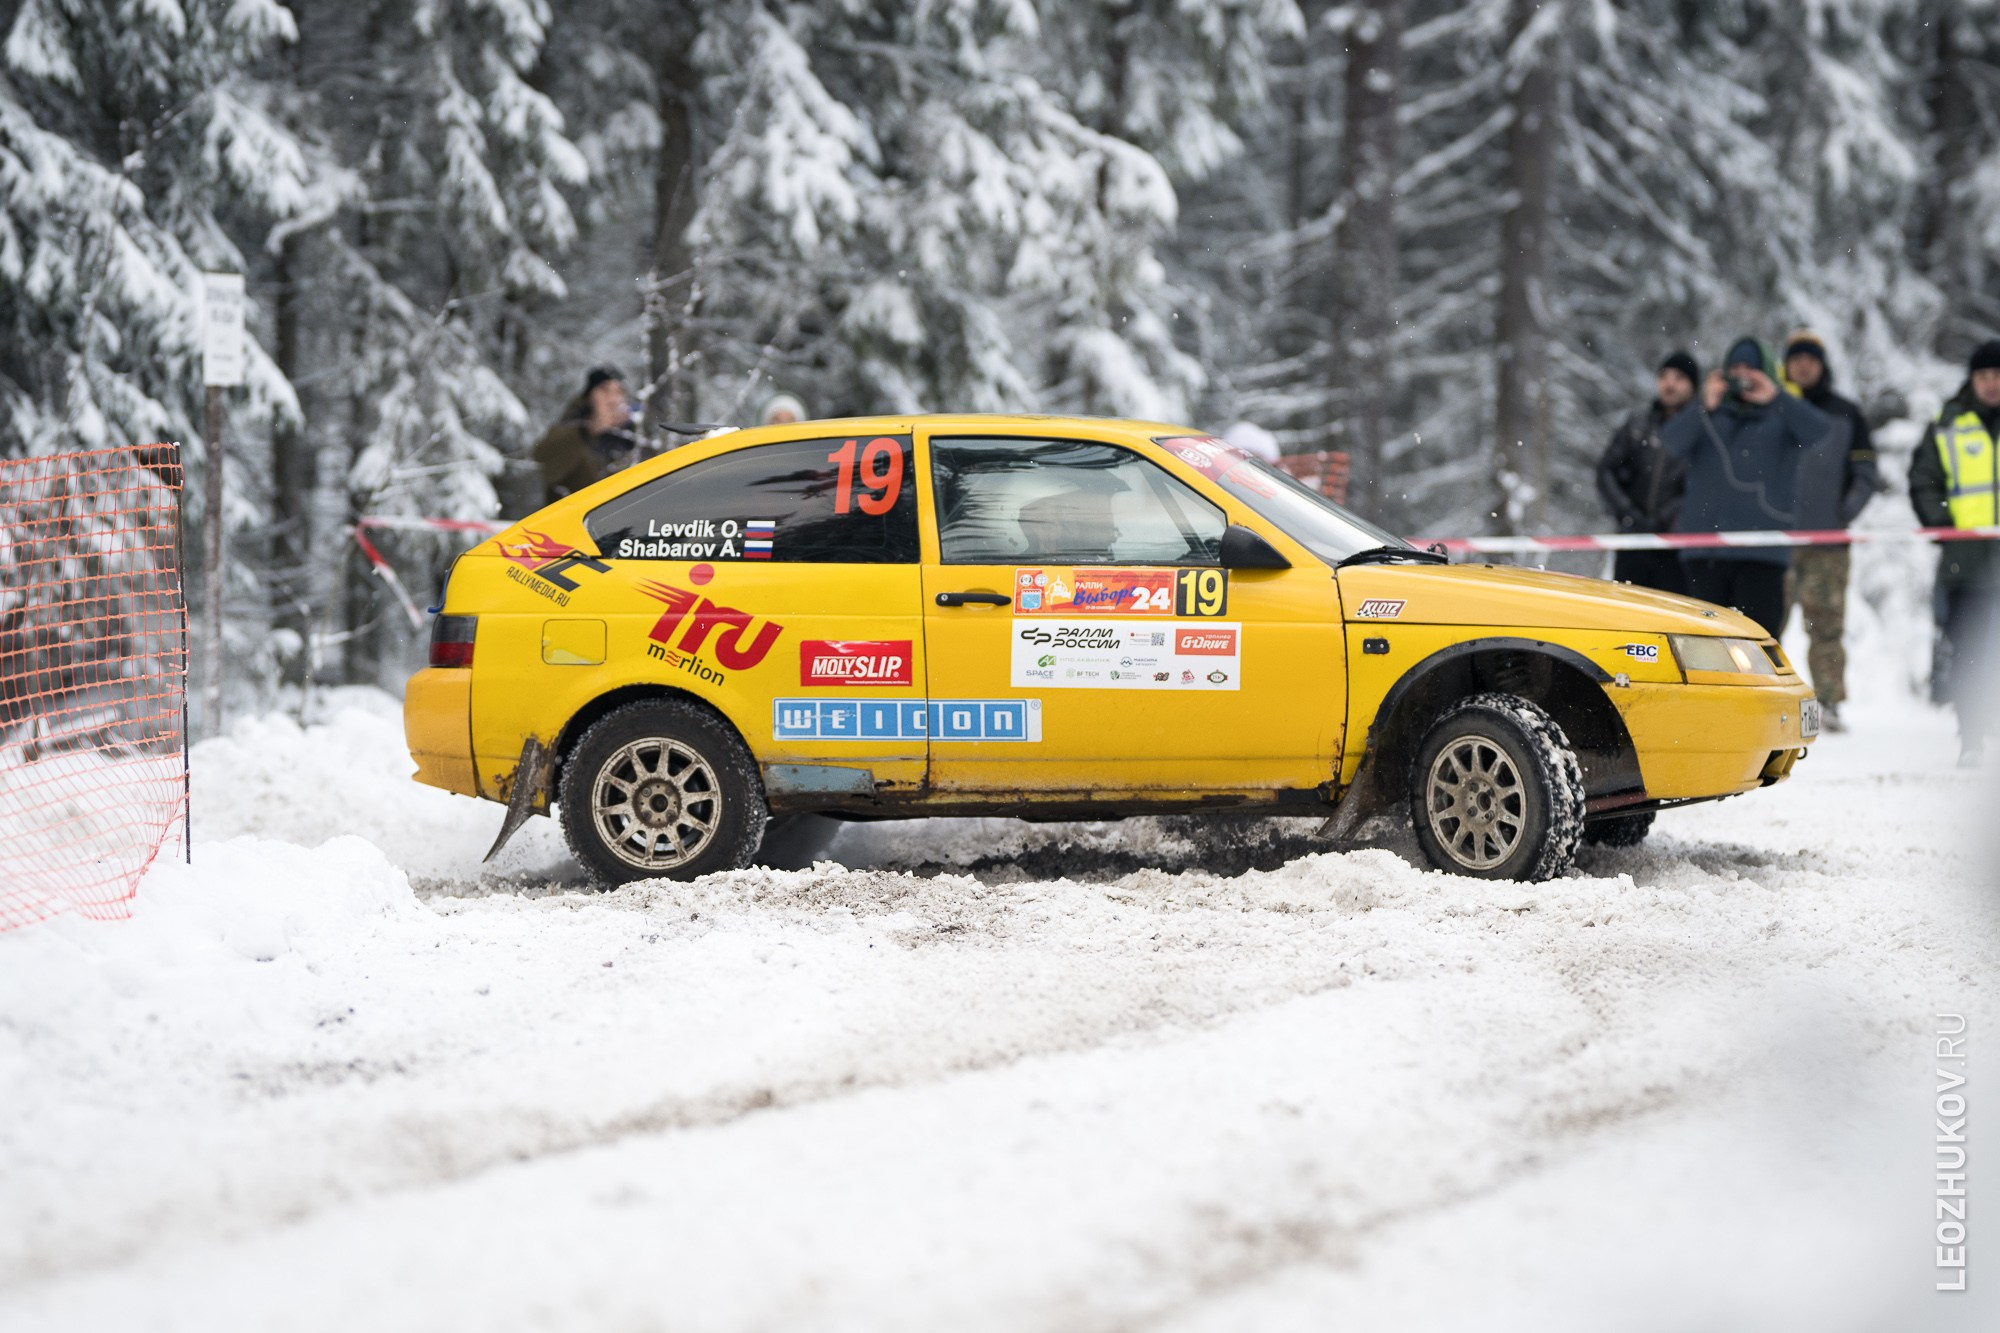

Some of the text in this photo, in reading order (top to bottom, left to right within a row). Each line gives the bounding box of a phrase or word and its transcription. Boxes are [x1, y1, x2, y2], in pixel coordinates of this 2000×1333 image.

[827, 437, 904, 516] 19
[648, 519, 743, 538] Levdik O.
[618, 538, 741, 557] Shabarov A.
[505, 565, 571, 608] RALLYMEDIA.RU
[1180, 569, 1224, 616] 19
[1130, 587, 1171, 610] 24
[1363, 602, 1402, 613] KLOTZ
[1056, 627, 1114, 638] РАЛЛИ
[1052, 639, 1120, 648] РОССИИ
[1626, 645, 1657, 656] EBC
